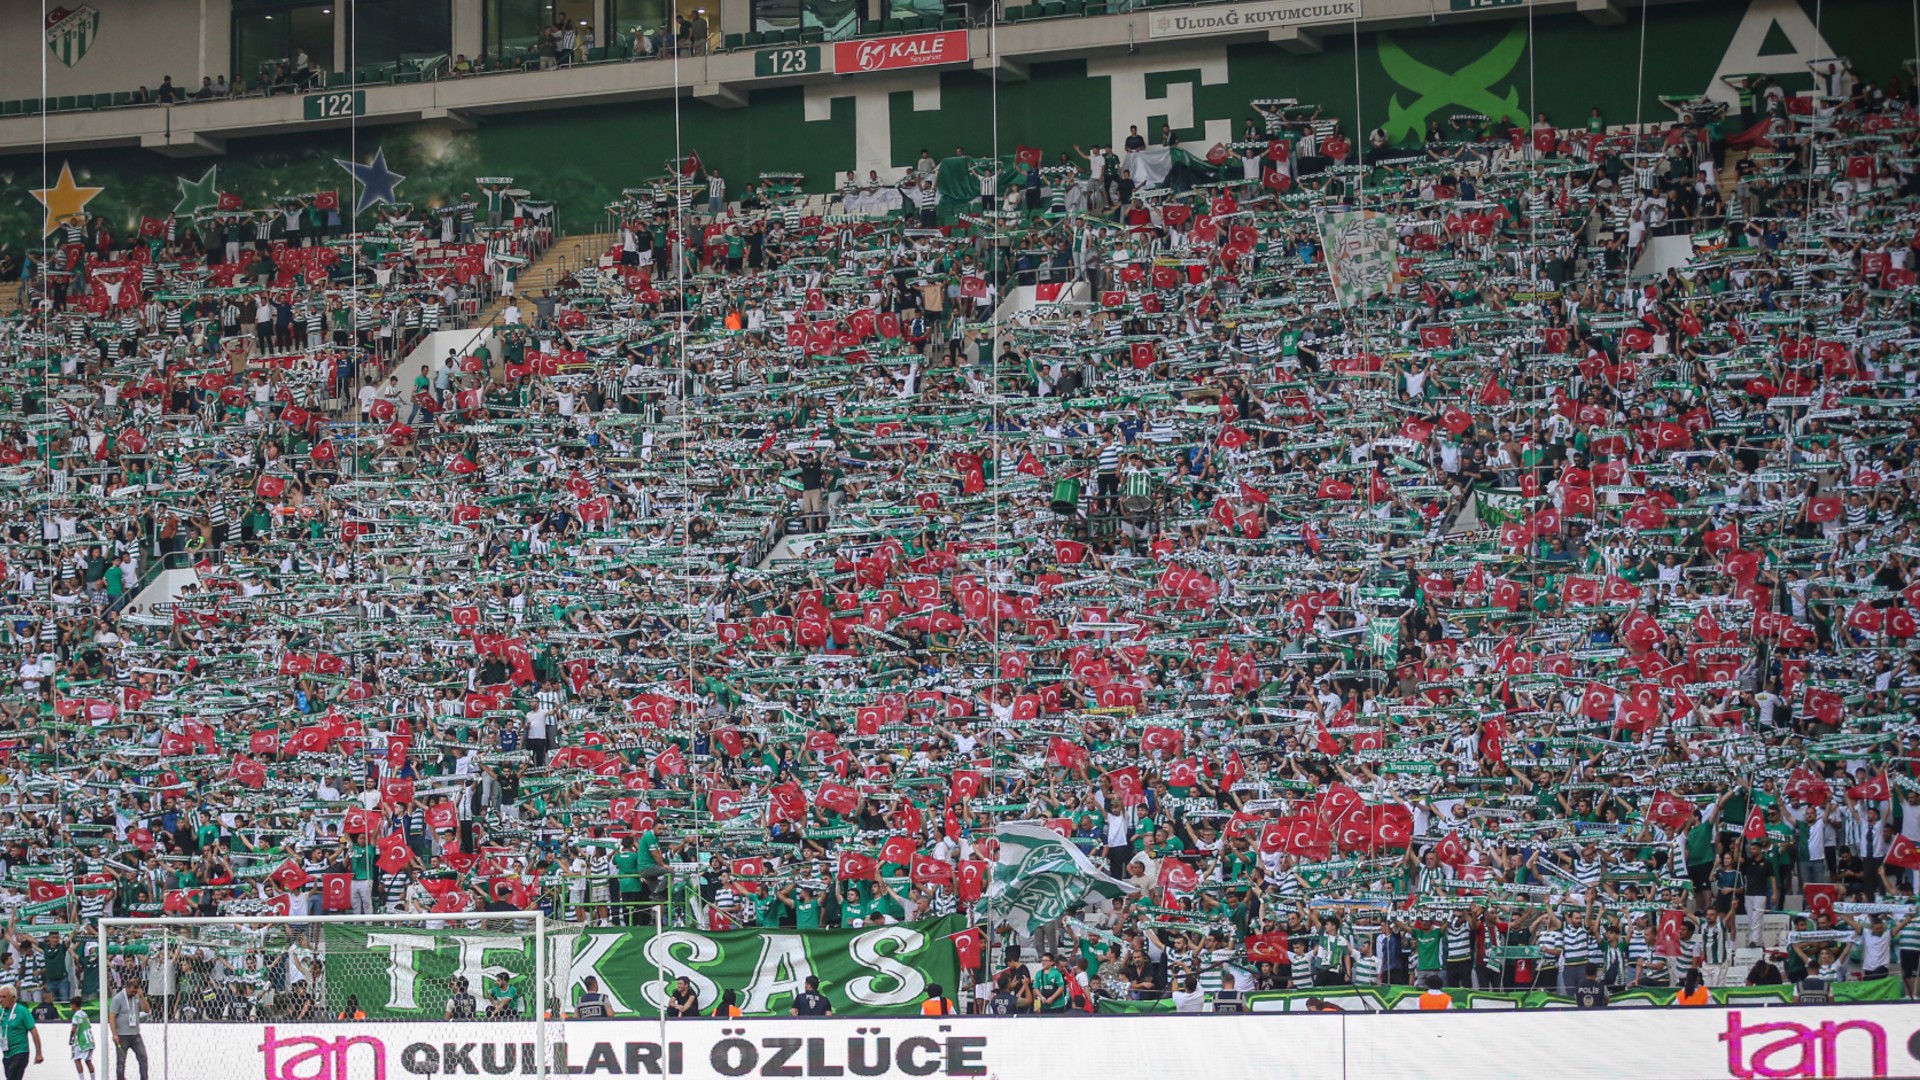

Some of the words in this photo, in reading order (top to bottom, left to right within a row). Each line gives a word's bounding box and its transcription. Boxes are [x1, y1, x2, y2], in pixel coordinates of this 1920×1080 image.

[1175, 9, 1239, 30] ULUDAĞ
[1245, 2, 1355, 25] KUYUMCULUK
[889, 38, 945, 58] KALE
[769, 50, 807, 74] 123
[910, 53, 942, 64] Seyahat
[317, 93, 352, 117] 122
[1557, 421, 1564, 433] 8
[1390, 762, 1433, 773] Bursaspor
[808, 826, 850, 838] Bursaspor
[1300, 862, 1328, 871] TEKSAS
[1445, 879, 1473, 887] TEKSAS
[1390, 908, 1451, 922] BURSASPOR
[367, 926, 928, 1017] TEKSAS
[258, 1026, 386, 1080] tan
[400, 1041, 684, 1076] OKULLARI
[709, 1026, 988, 1077] ÖZLÜCE
[1718, 1010, 1887, 1079] tan
